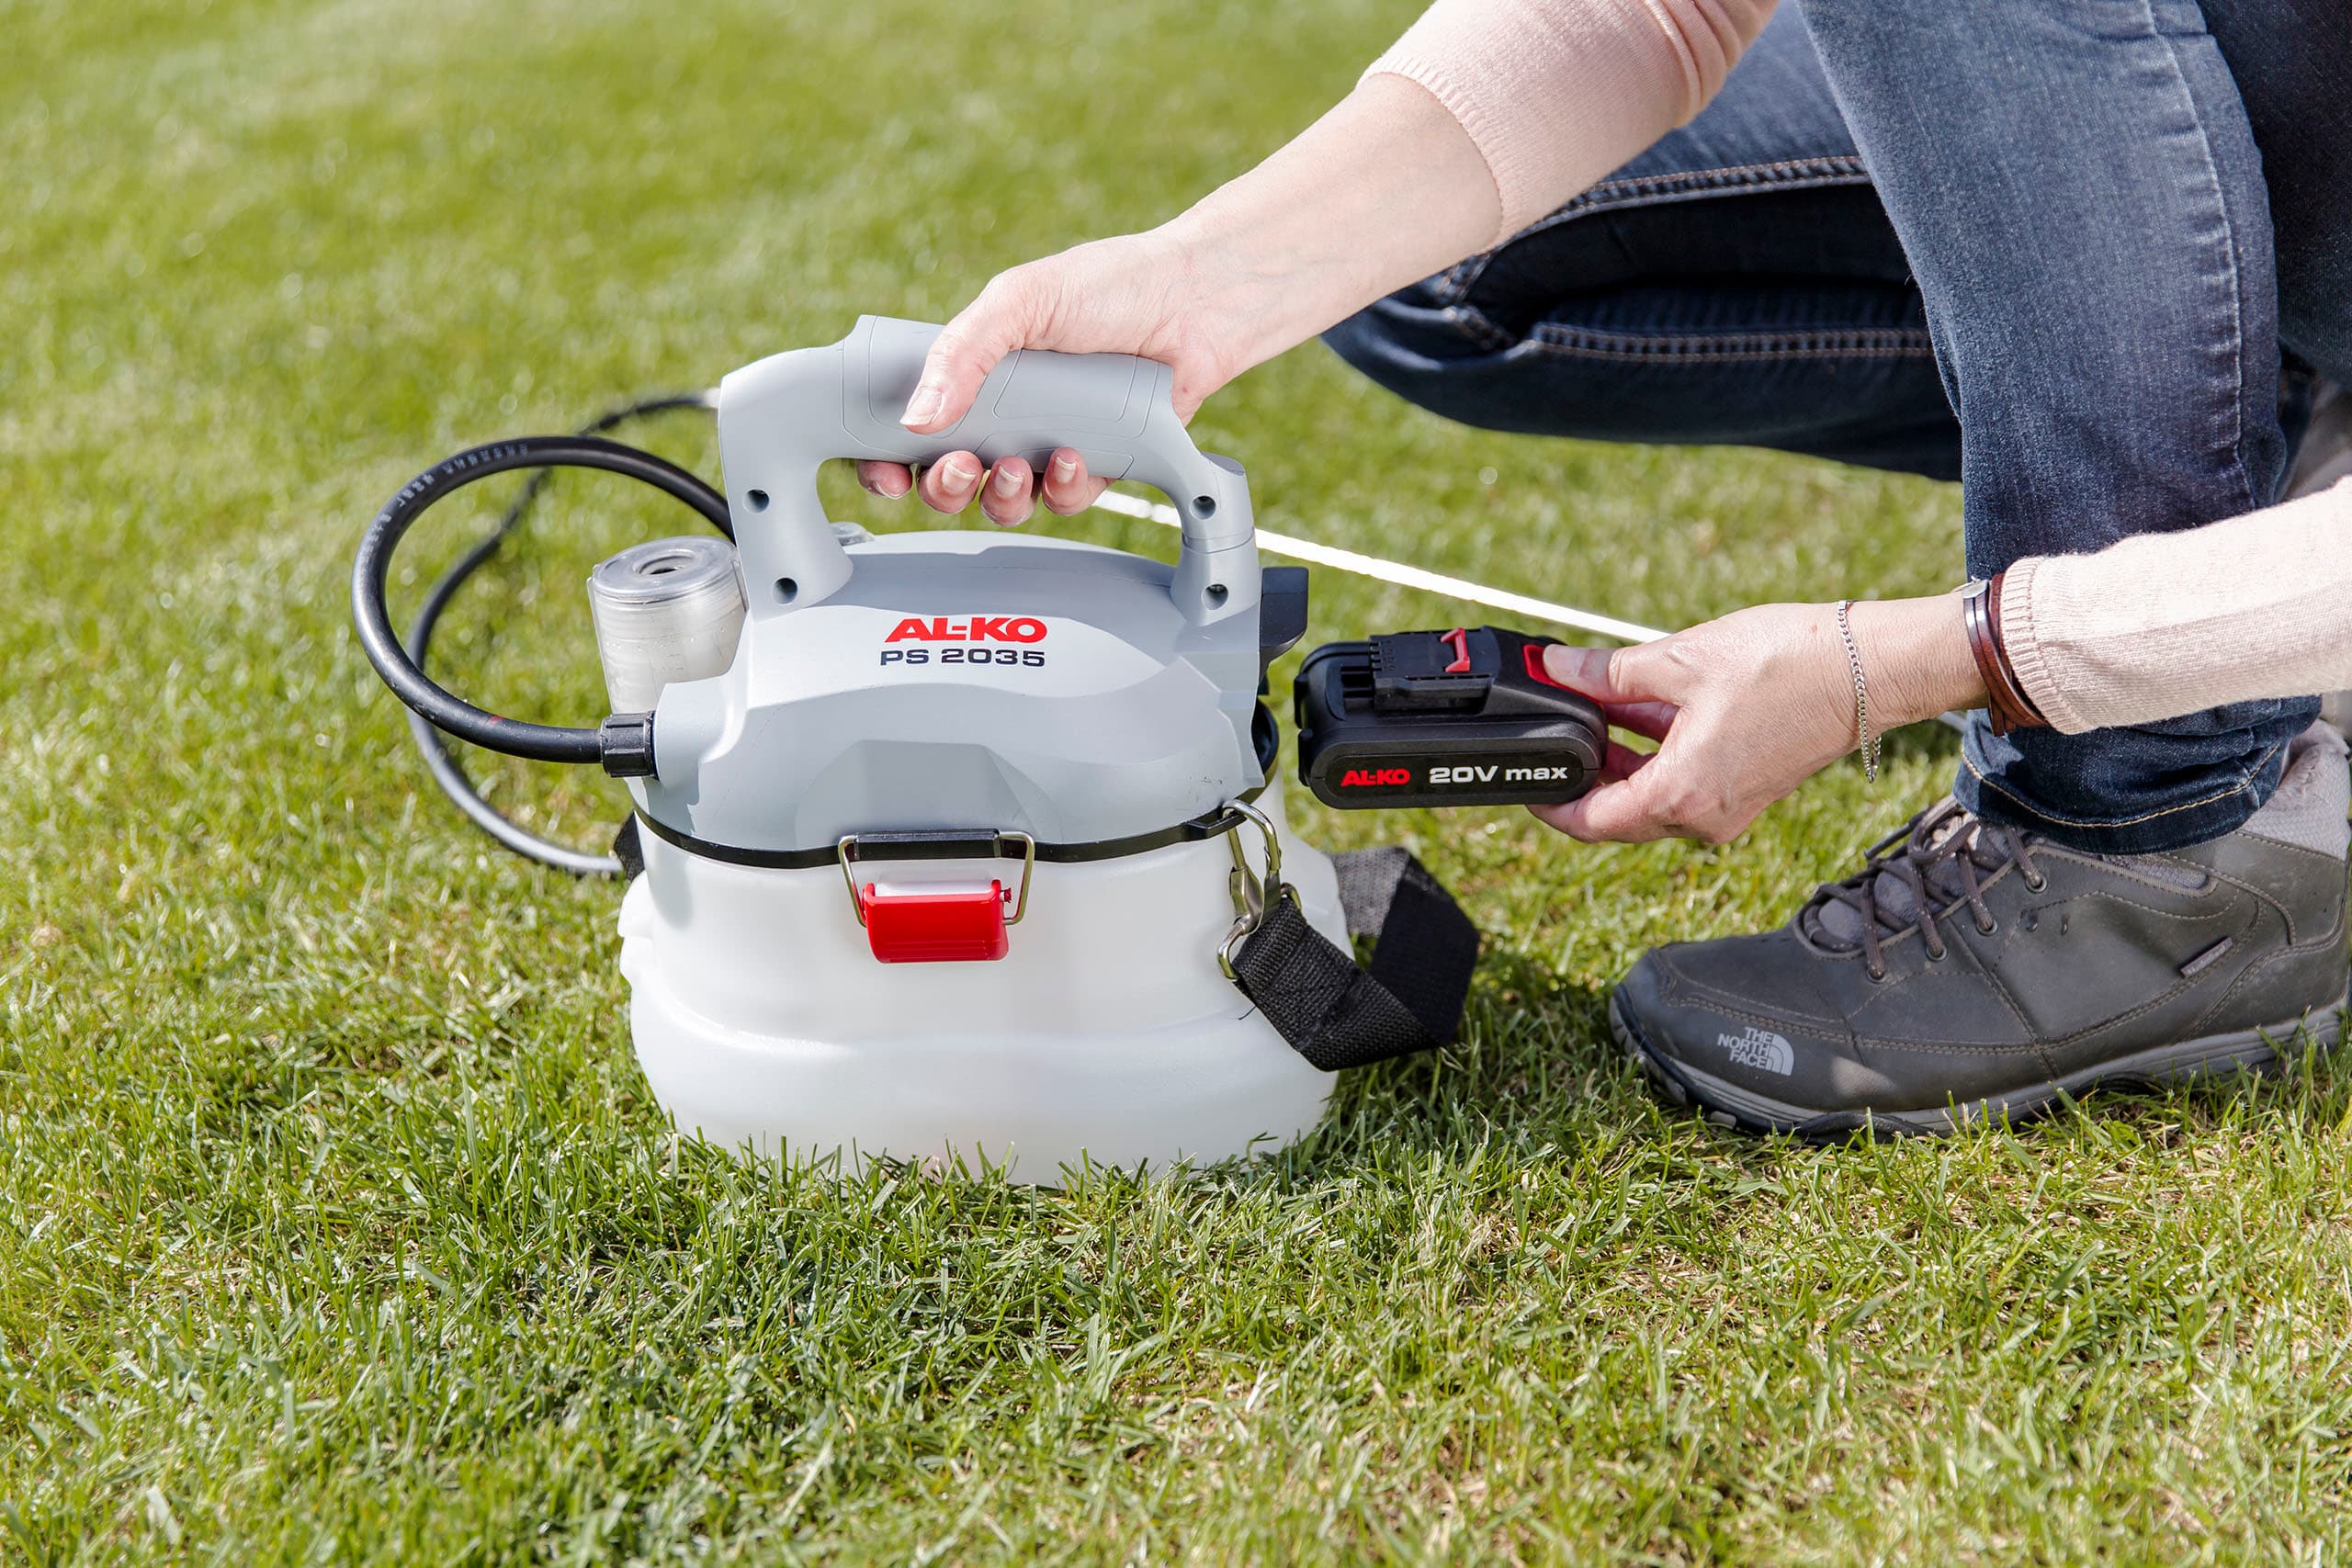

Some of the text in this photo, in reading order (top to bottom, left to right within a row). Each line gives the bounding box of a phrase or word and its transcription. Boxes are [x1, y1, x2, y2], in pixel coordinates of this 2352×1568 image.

[884, 616, 1047, 643] AL-KO
[880, 648, 1046, 667] PS 2035
[1340, 765, 1568, 787] AL-KO 20V max
[1716, 1032, 1770, 1057] NORTH
[1745, 1026, 1774, 1044] THE
[1729, 1047, 1768, 1069] FACE
